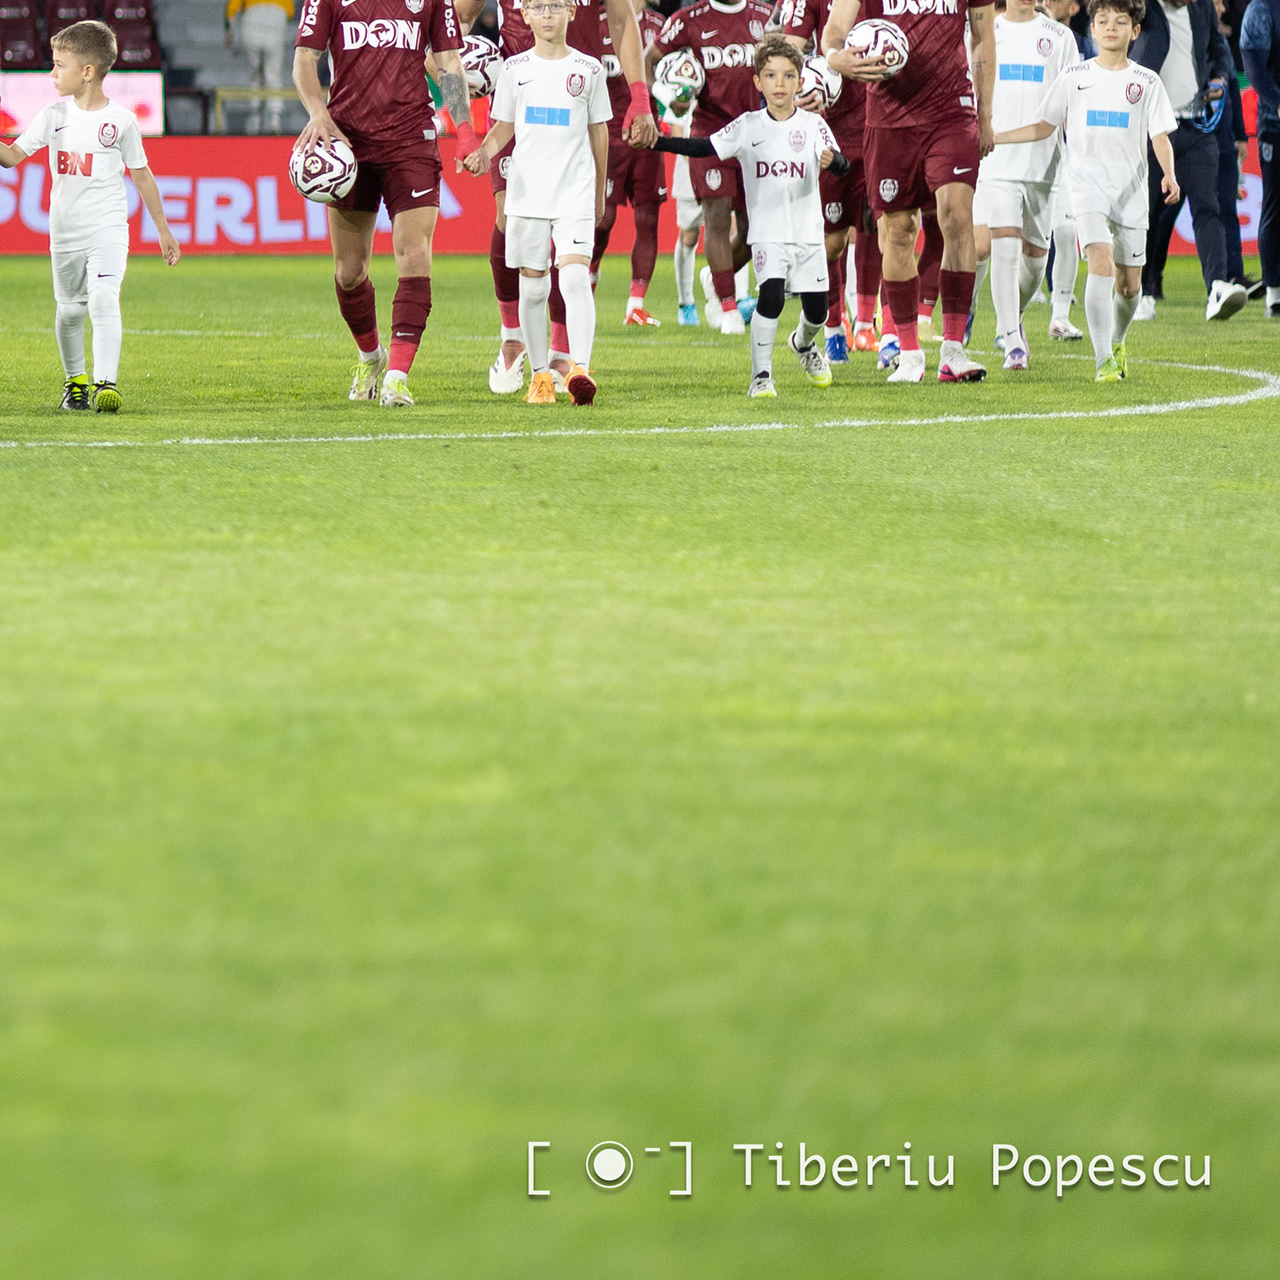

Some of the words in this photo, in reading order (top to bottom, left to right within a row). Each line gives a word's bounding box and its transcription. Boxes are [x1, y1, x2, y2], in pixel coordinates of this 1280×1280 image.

[340, 19, 422, 51] DON
[444, 7, 456, 38] DSC
[756, 161, 806, 180] DON
